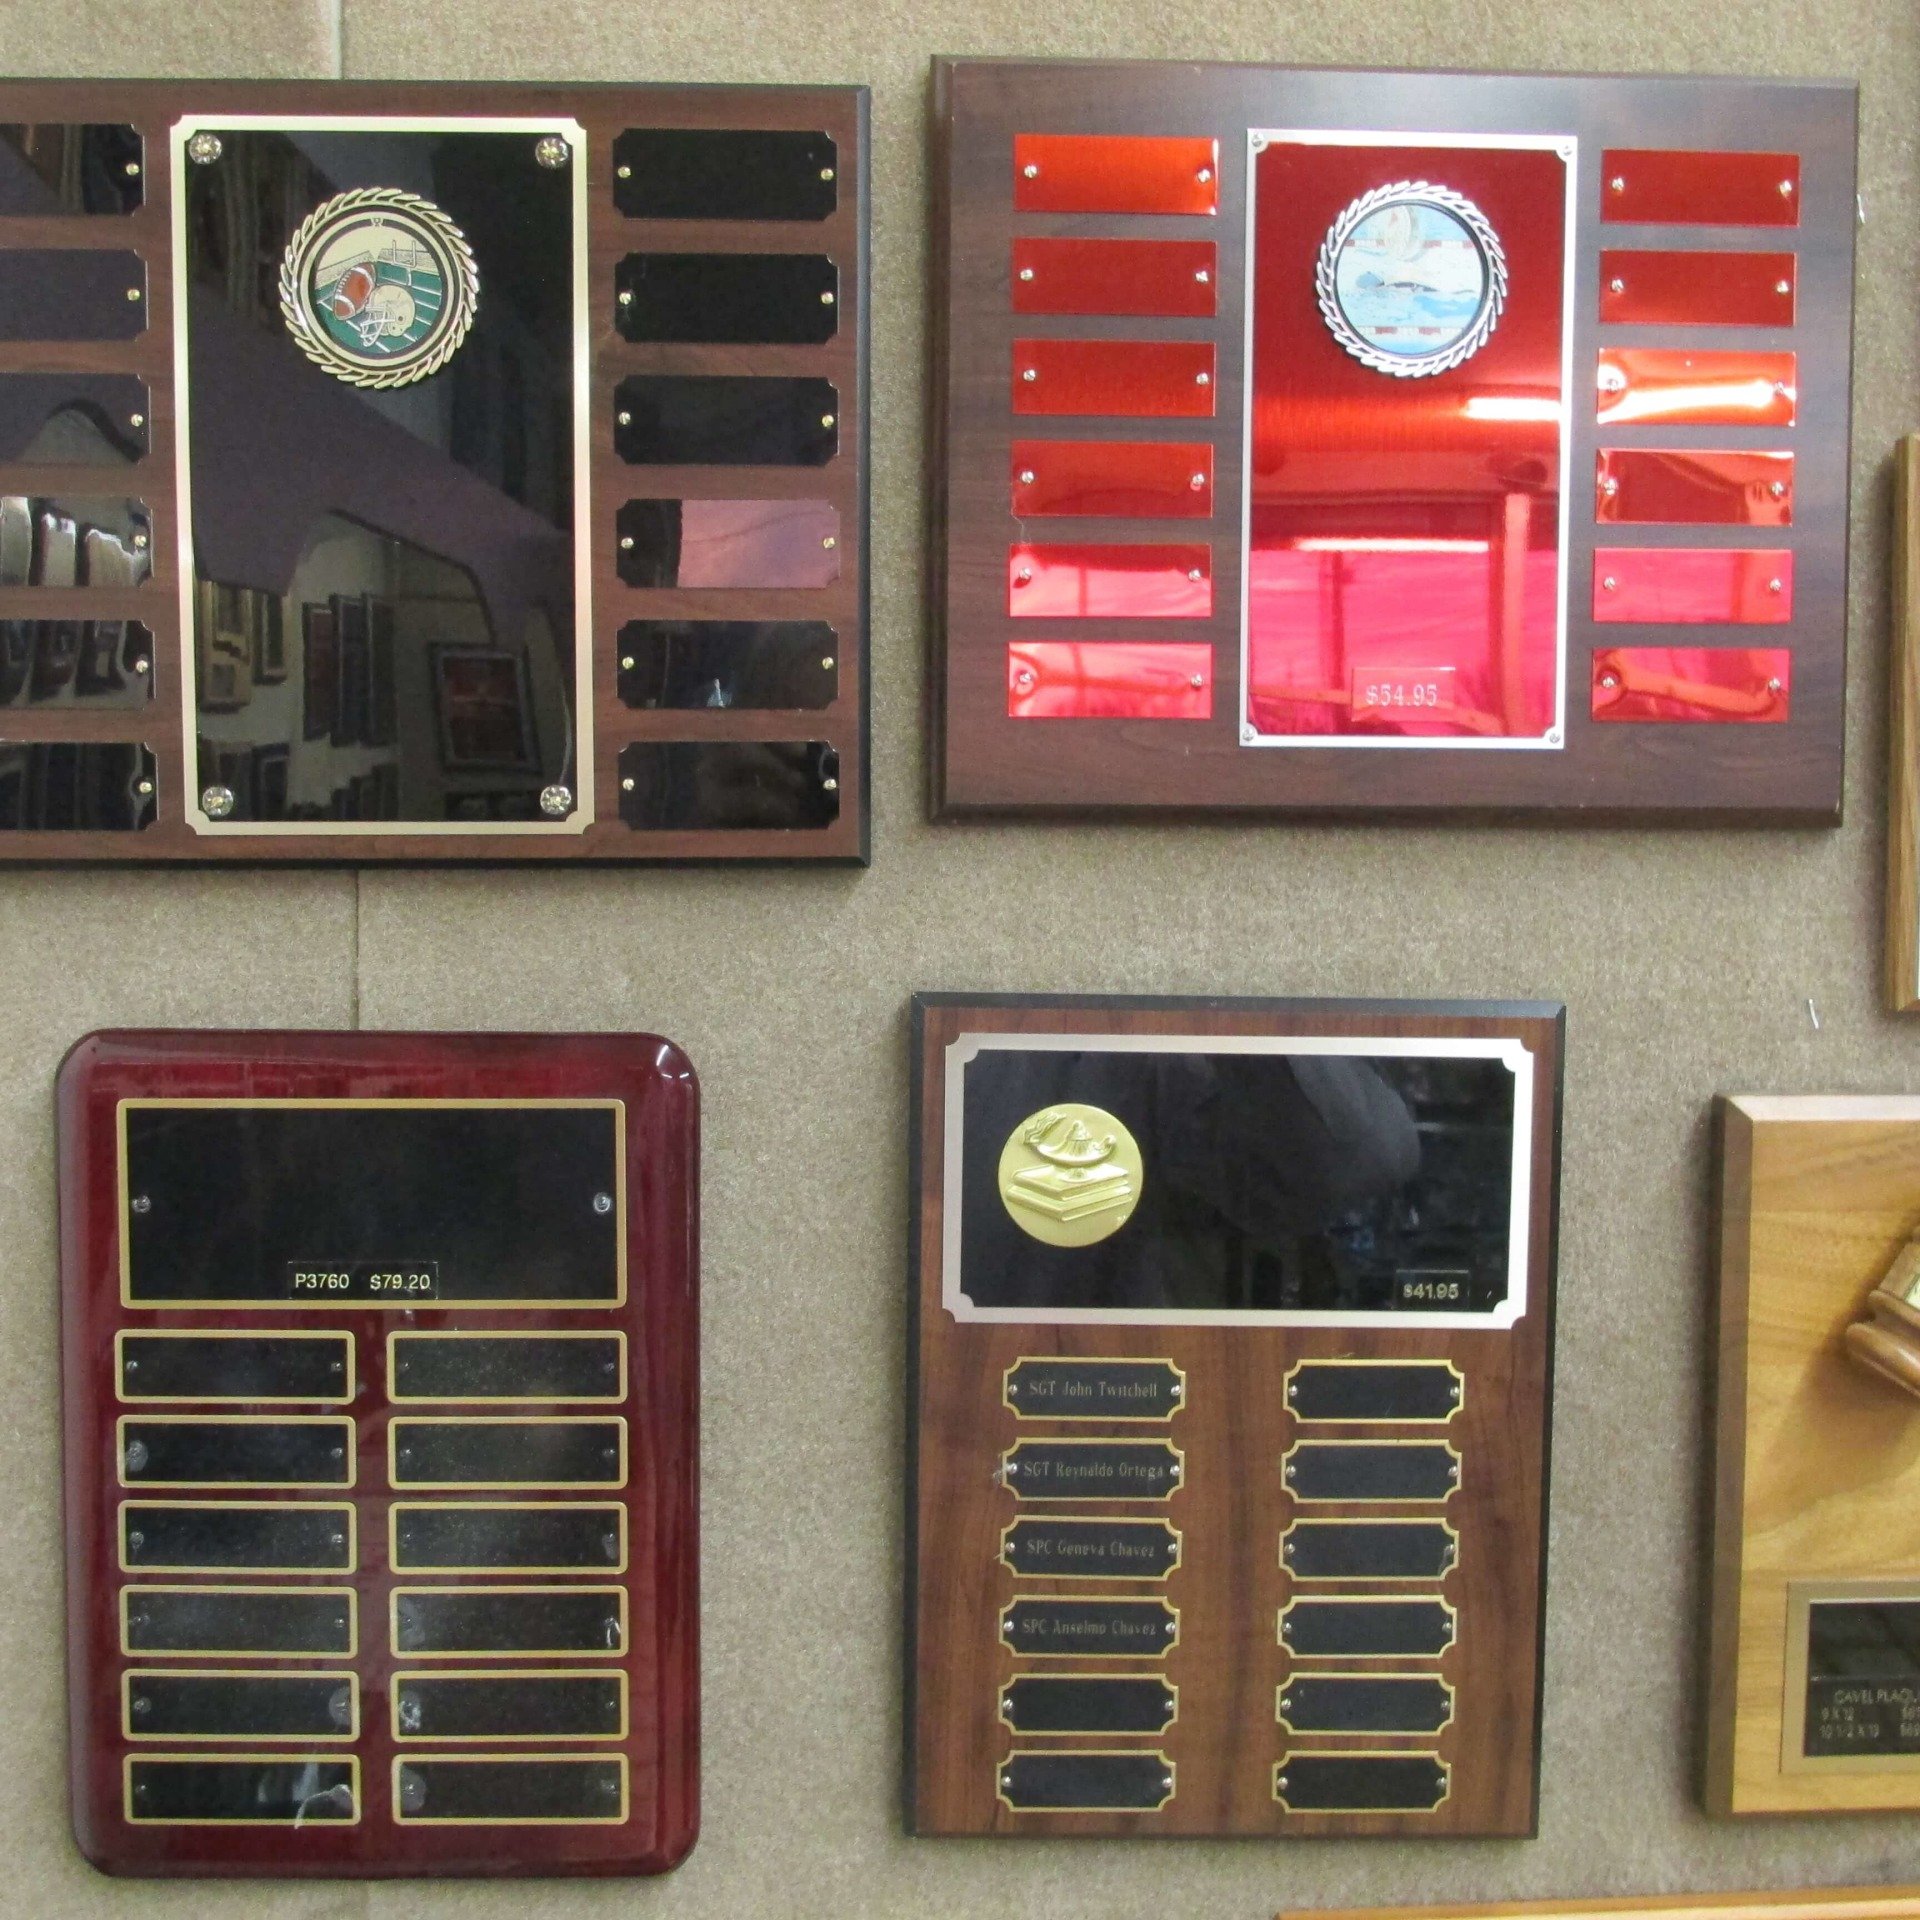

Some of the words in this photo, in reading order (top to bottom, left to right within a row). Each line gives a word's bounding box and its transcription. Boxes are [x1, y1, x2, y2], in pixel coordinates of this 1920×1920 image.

[1366, 684, 1437, 707] $54.95
[295, 1273, 350, 1289] P3760
[369, 1273, 431, 1290] $79.20
[1029, 1380, 1056, 1396] SGT
[1062, 1381, 1092, 1397] John
[1099, 1381, 1158, 1398] Twitchell
[1023, 1461, 1050, 1478] SGT
[1056, 1462, 1114, 1481] Reynaldo
[1119, 1462, 1164, 1480] Ortega
[1027, 1539, 1052, 1555] SPC
[1058, 1540, 1105, 1557] Geneva
[1110, 1541, 1155, 1558] Chavez
[1022, 1618, 1047, 1635] SPC
[1053, 1619, 1107, 1635] Anselmo
[1112, 1620, 1156, 1636] Chavez
